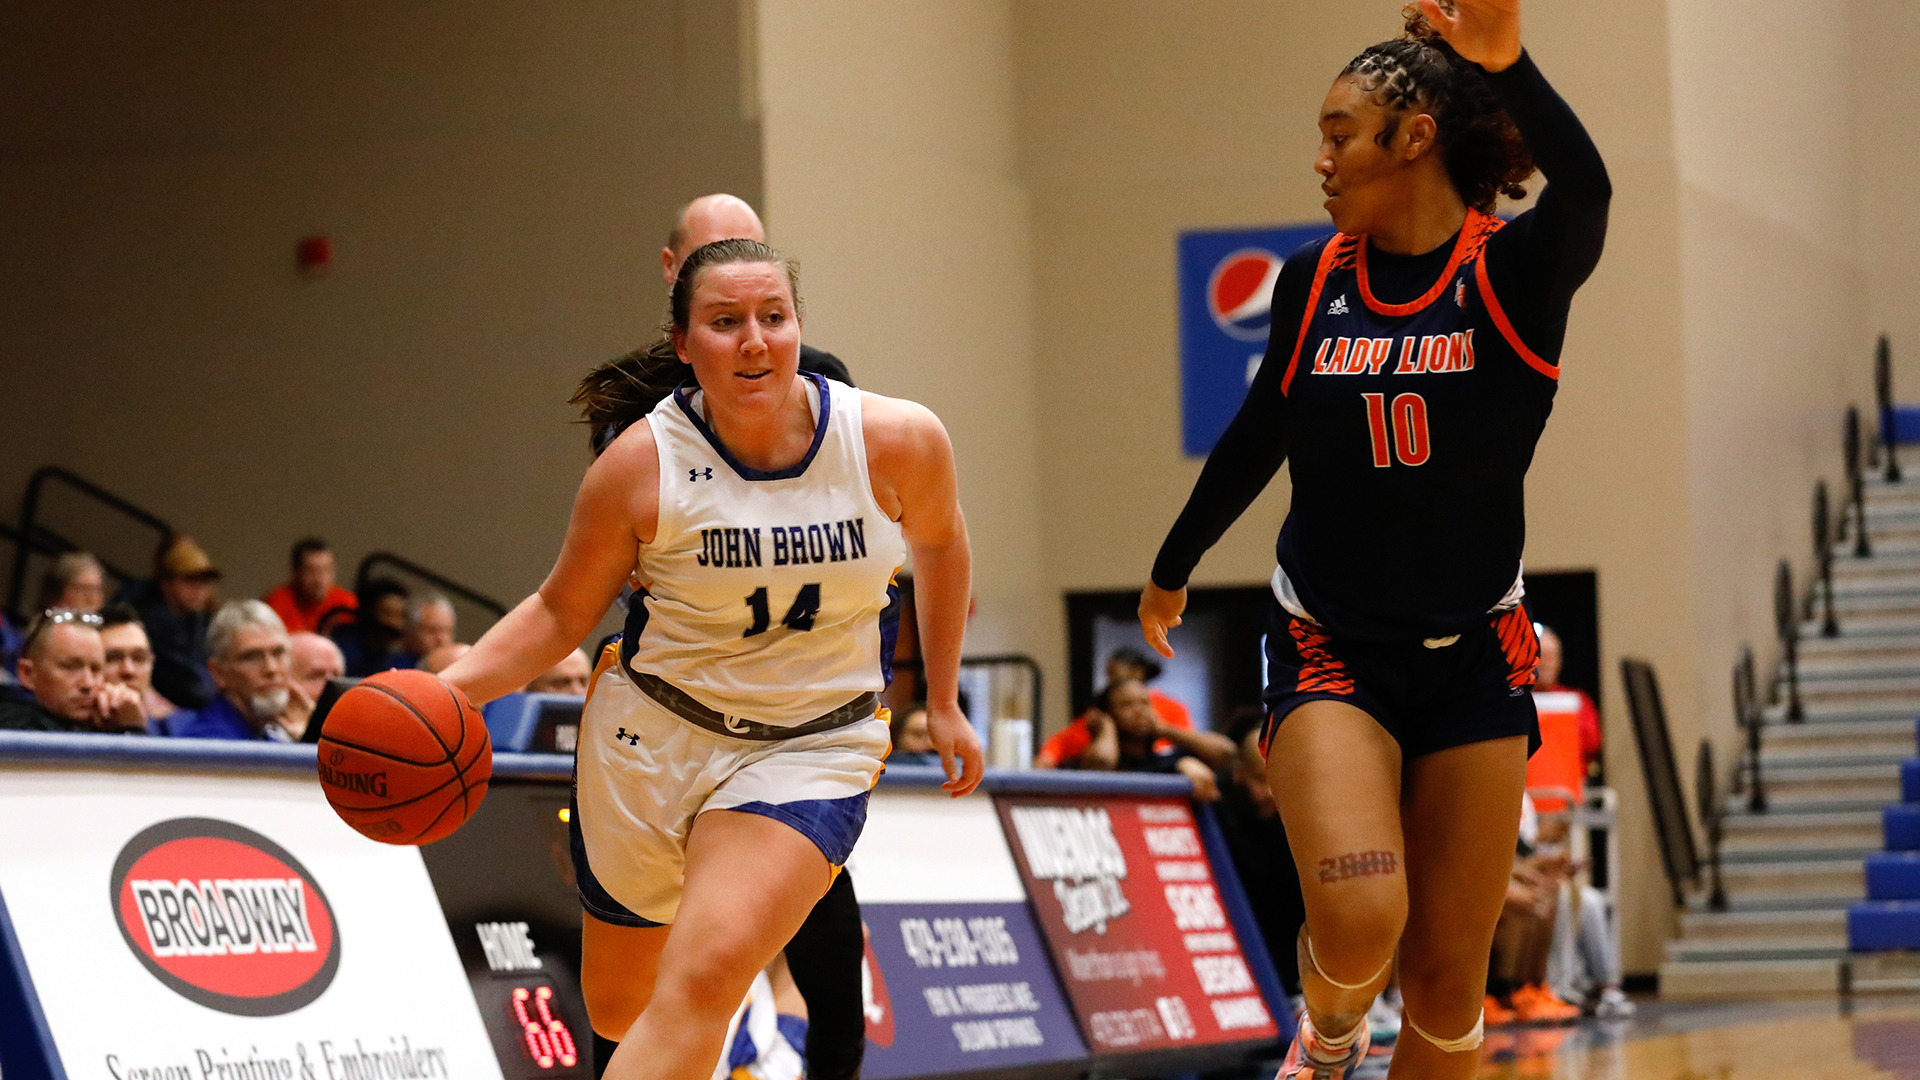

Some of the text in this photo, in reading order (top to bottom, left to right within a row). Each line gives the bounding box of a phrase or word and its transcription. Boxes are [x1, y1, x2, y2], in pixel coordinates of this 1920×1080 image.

[1311, 337, 1393, 375] LADY
[1393, 328, 1475, 375] LIONS
[1361, 392, 1431, 468] 10
[697, 517, 868, 568] JOHN BROWN
[742, 582, 822, 638] 14
[318, 763, 388, 798] ALDING
[130, 878, 317, 956] BROADWAY
[475, 921, 543, 971] HOME
[513, 986, 577, 1068] 66
[296, 1041, 316, 1080] &
[319, 1035, 448, 1080] Embroidery
